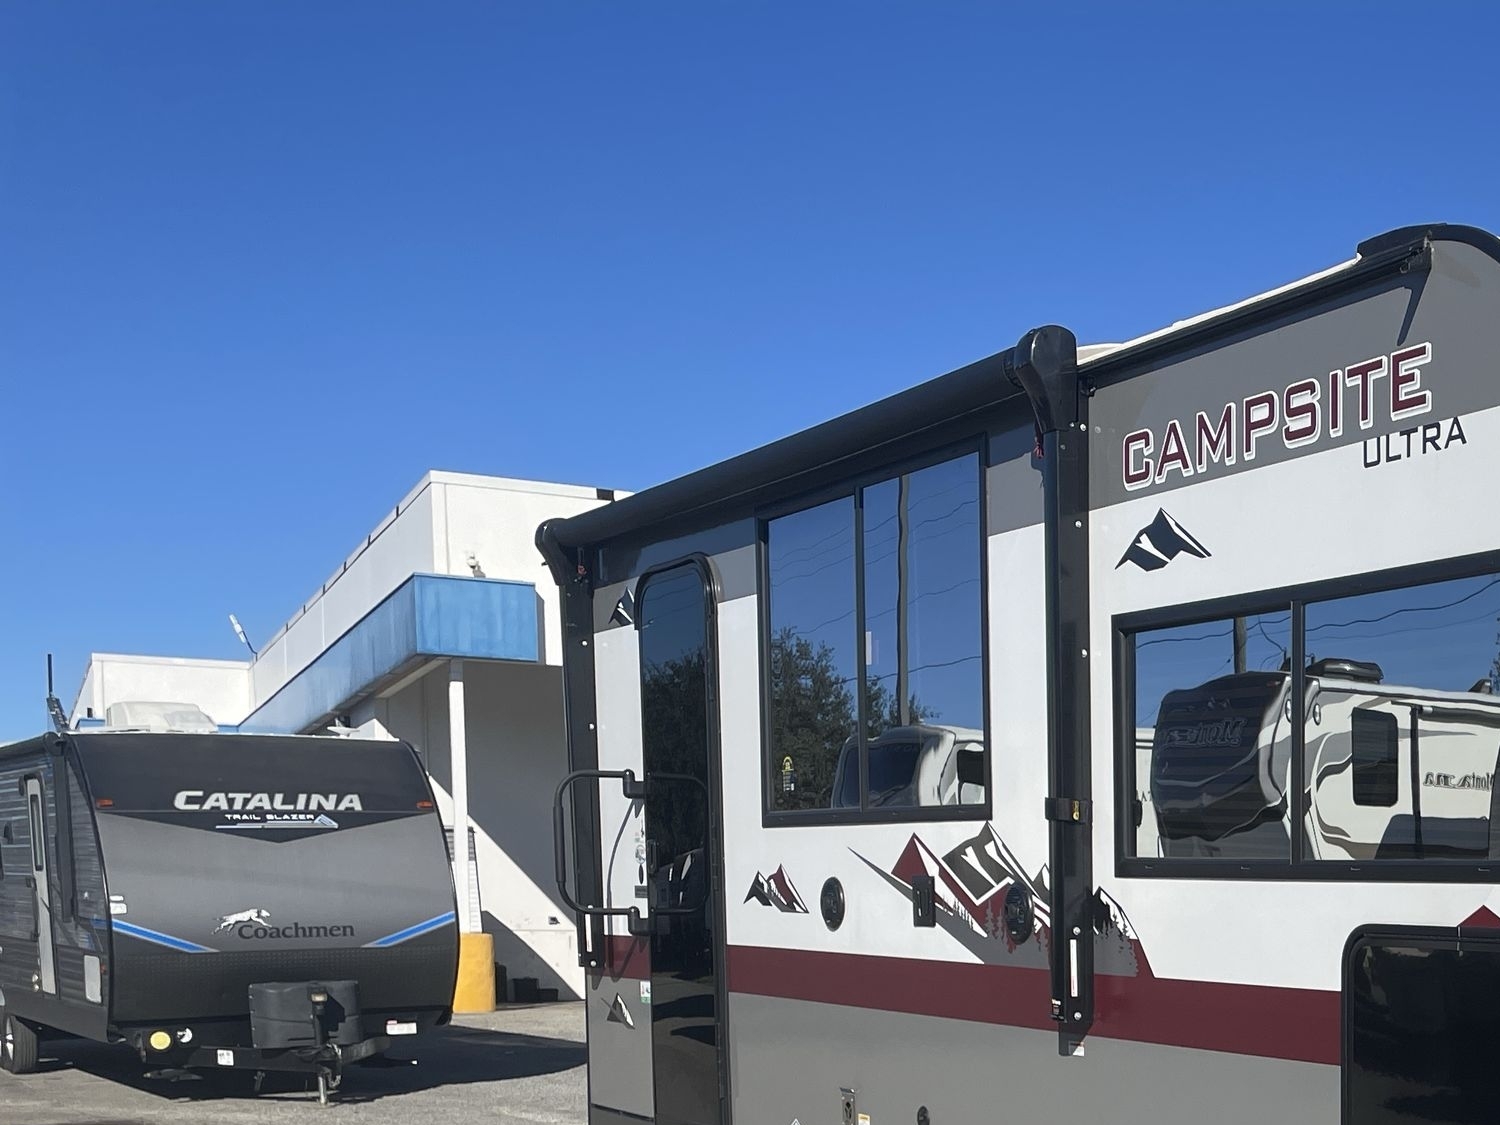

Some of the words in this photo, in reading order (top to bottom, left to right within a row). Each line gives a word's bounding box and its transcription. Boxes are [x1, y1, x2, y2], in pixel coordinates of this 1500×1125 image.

[1122, 340, 1432, 491] CAMPSITE
[1363, 416, 1467, 468] ULTRA
[173, 790, 363, 811] CATALINA
[238, 922, 355, 939] Coachmen
